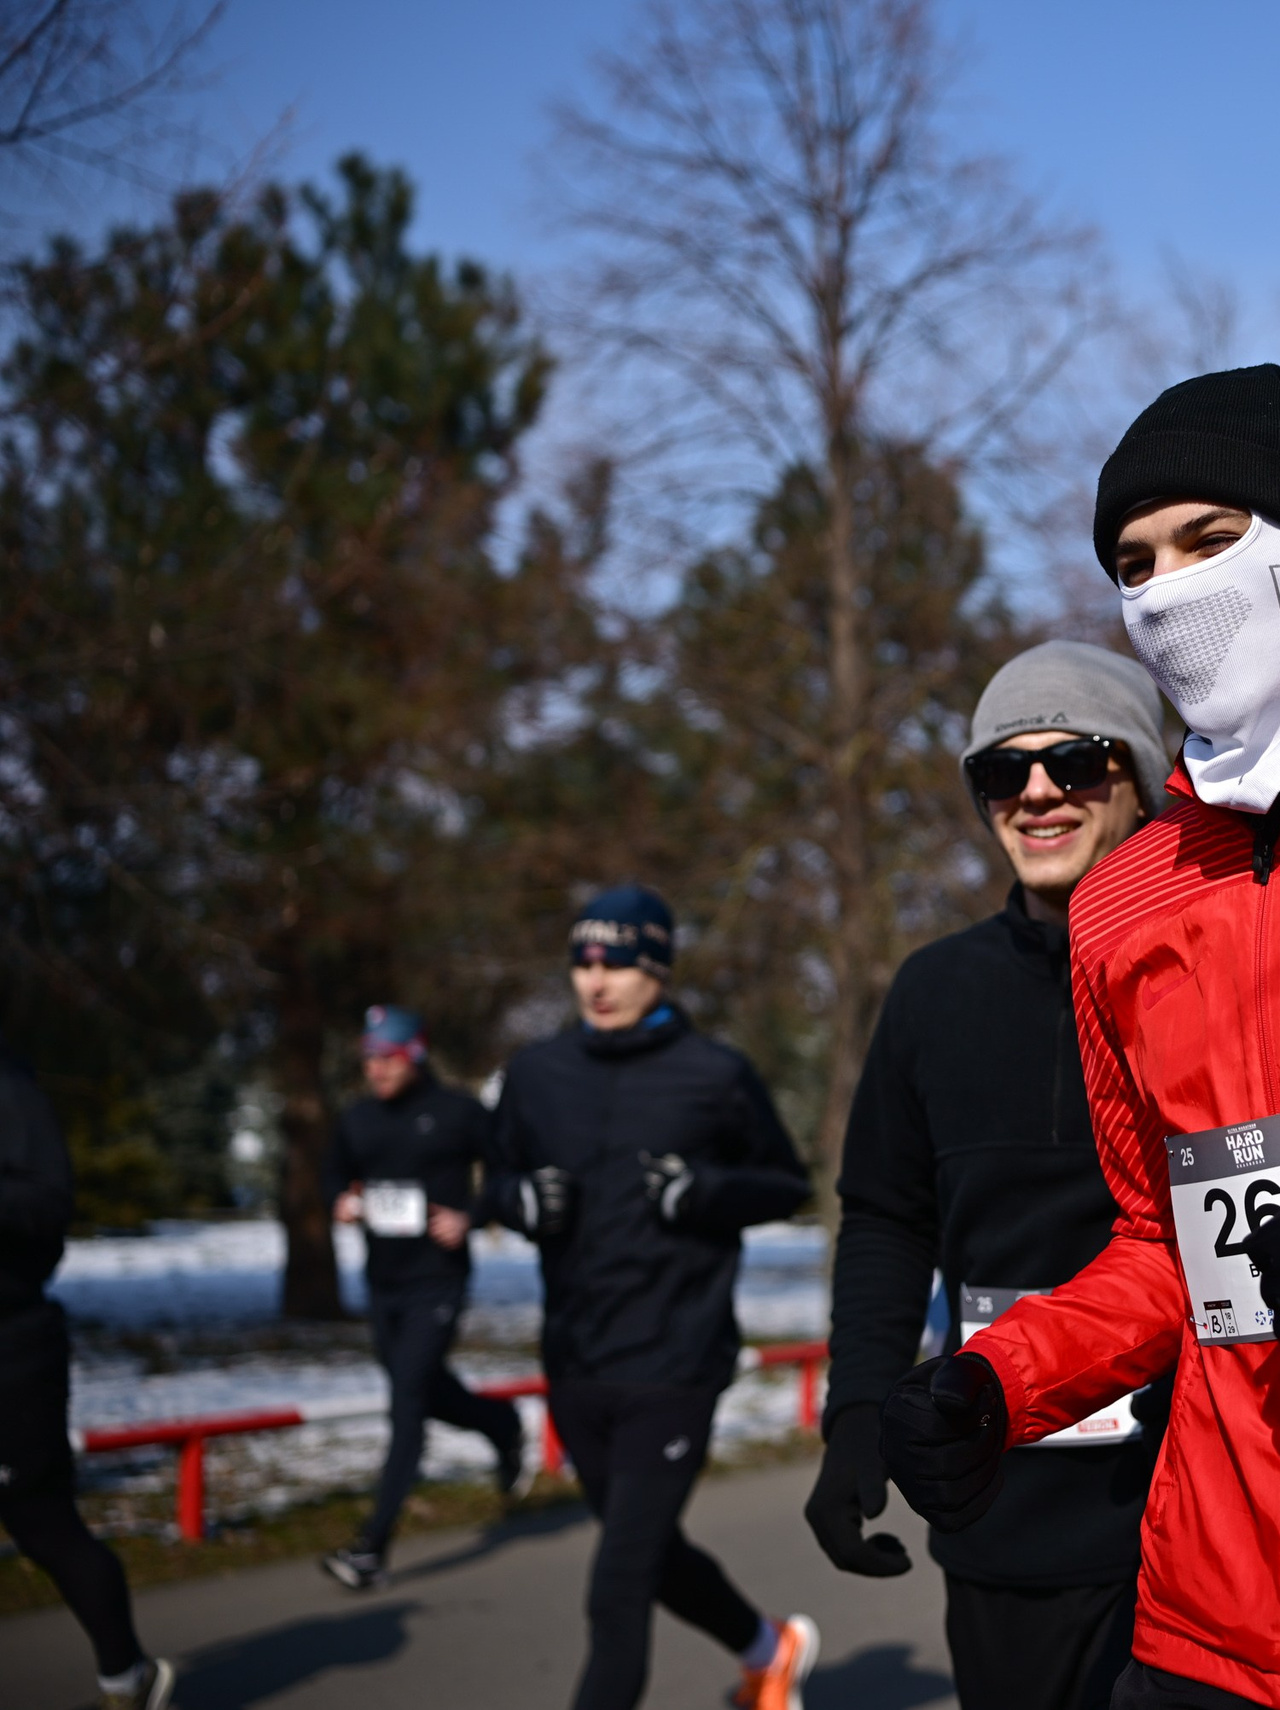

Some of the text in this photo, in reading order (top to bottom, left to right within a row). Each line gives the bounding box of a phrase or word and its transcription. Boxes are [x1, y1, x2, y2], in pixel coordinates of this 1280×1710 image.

[1225, 1129, 1264, 1151] HARD
[1180, 1147, 1195, 1167] 25
[1233, 1144, 1265, 1164] RUN
